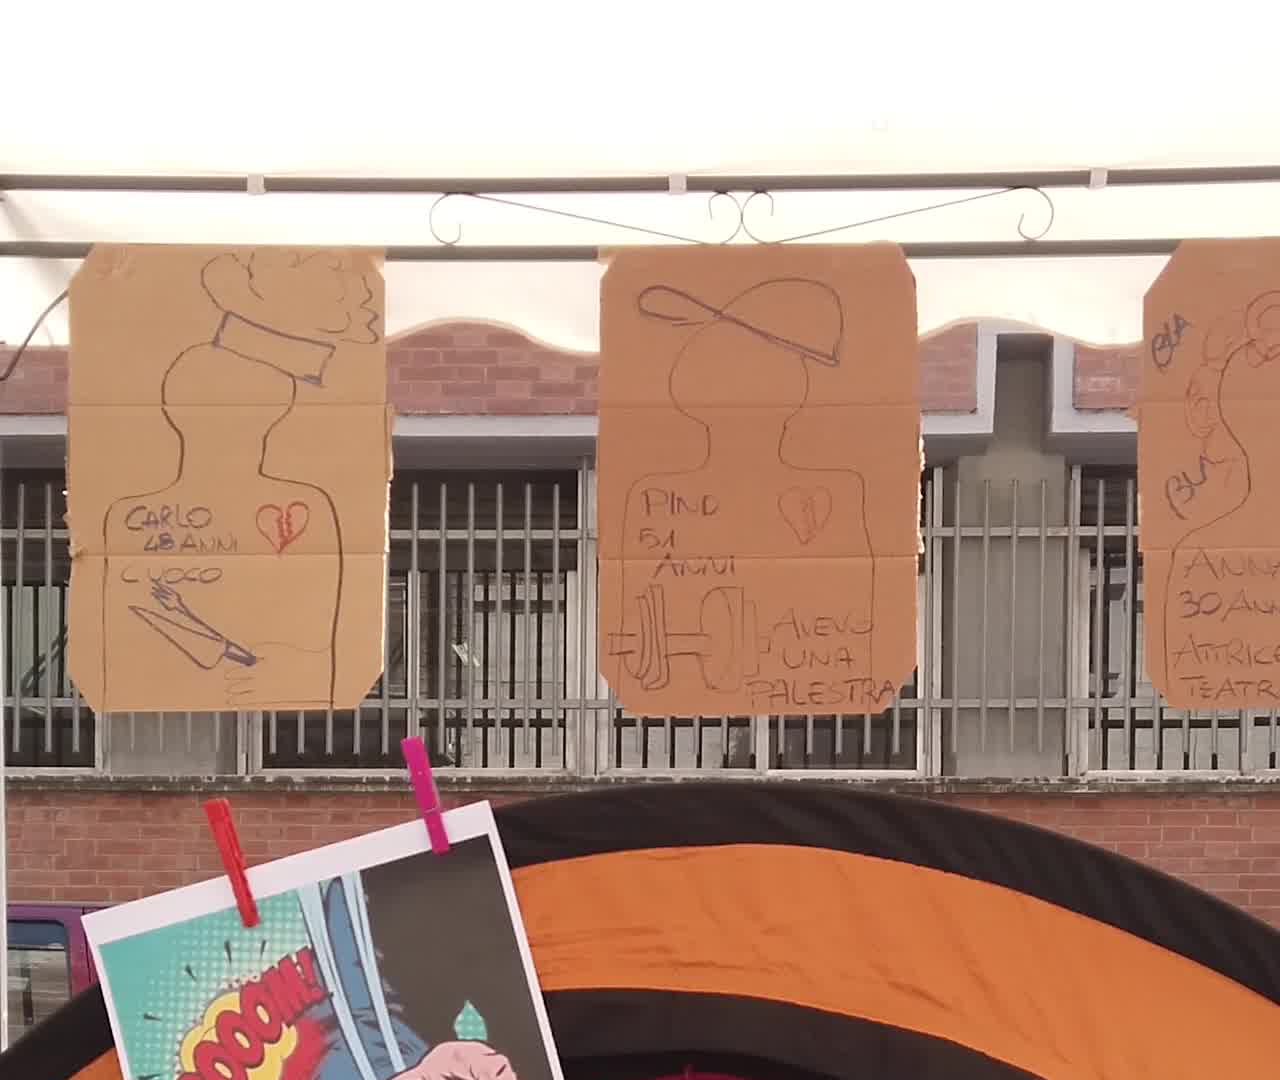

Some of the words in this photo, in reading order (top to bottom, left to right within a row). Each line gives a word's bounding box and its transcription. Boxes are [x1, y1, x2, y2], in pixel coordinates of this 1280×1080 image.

[124, 505, 213, 532] CARLO
[180, 532, 239, 553] ANNI
[653, 552, 736, 579] ANNI
[1177, 590, 1223, 619] 30
[773, 608, 875, 640] AVEVO
[782, 648, 855, 670] UNA
[745, 678, 897, 709] PALESTRA
